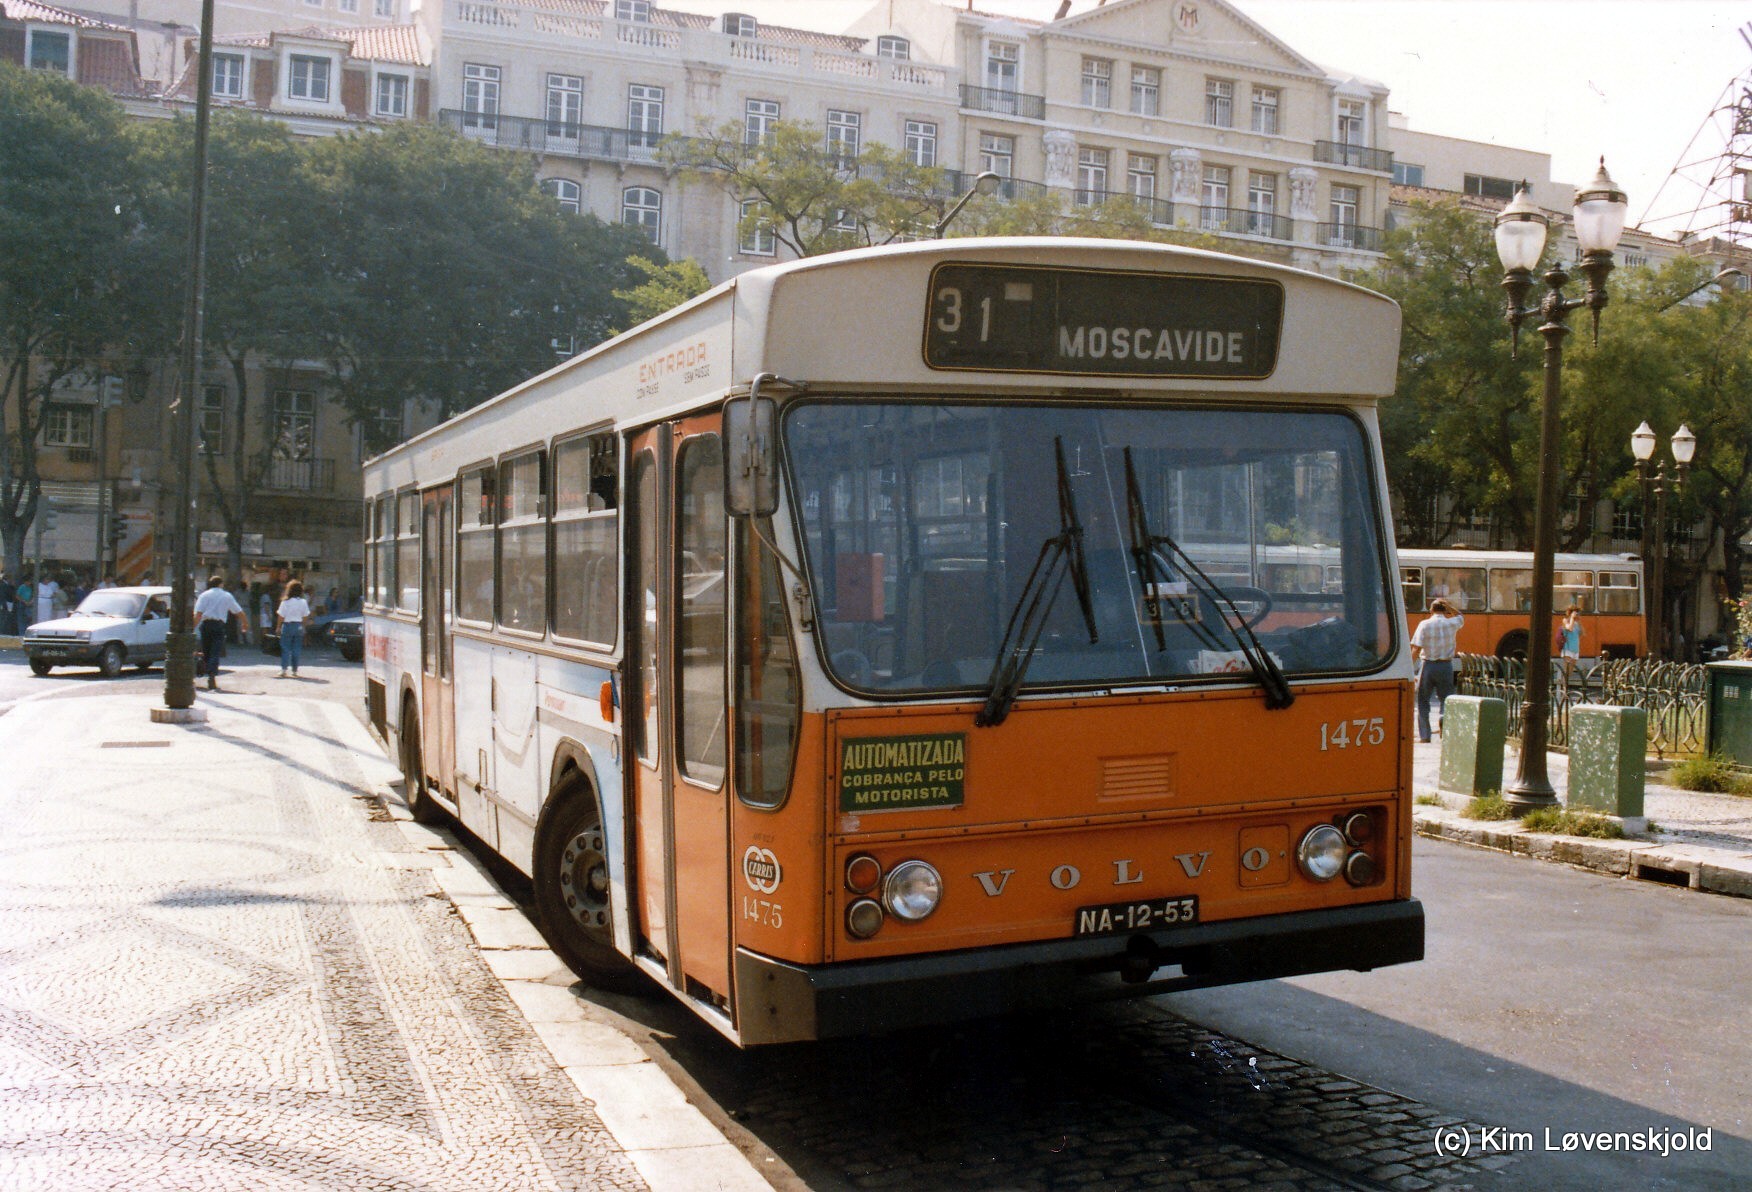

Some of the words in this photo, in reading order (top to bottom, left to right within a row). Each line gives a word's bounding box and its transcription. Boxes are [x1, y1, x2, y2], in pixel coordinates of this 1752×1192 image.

[1058, 325, 1243, 363] MOSCAVIDE
[639, 342, 706, 383] ENTRADA
[1320, 717, 1385, 751] 1475
[843, 739, 964, 771] AUTOMATIZADA
[842, 771, 923, 788] COBRANÇA
[928, 768, 964, 782] PELO
[855, 786, 949, 804] MOTORISTA
[748, 861, 774, 879] CARRIS
[972, 847, 1270, 897] VOLVO
[743, 895, 783, 929] 1475
[1079, 899, 1195, 934] NA-12-53
